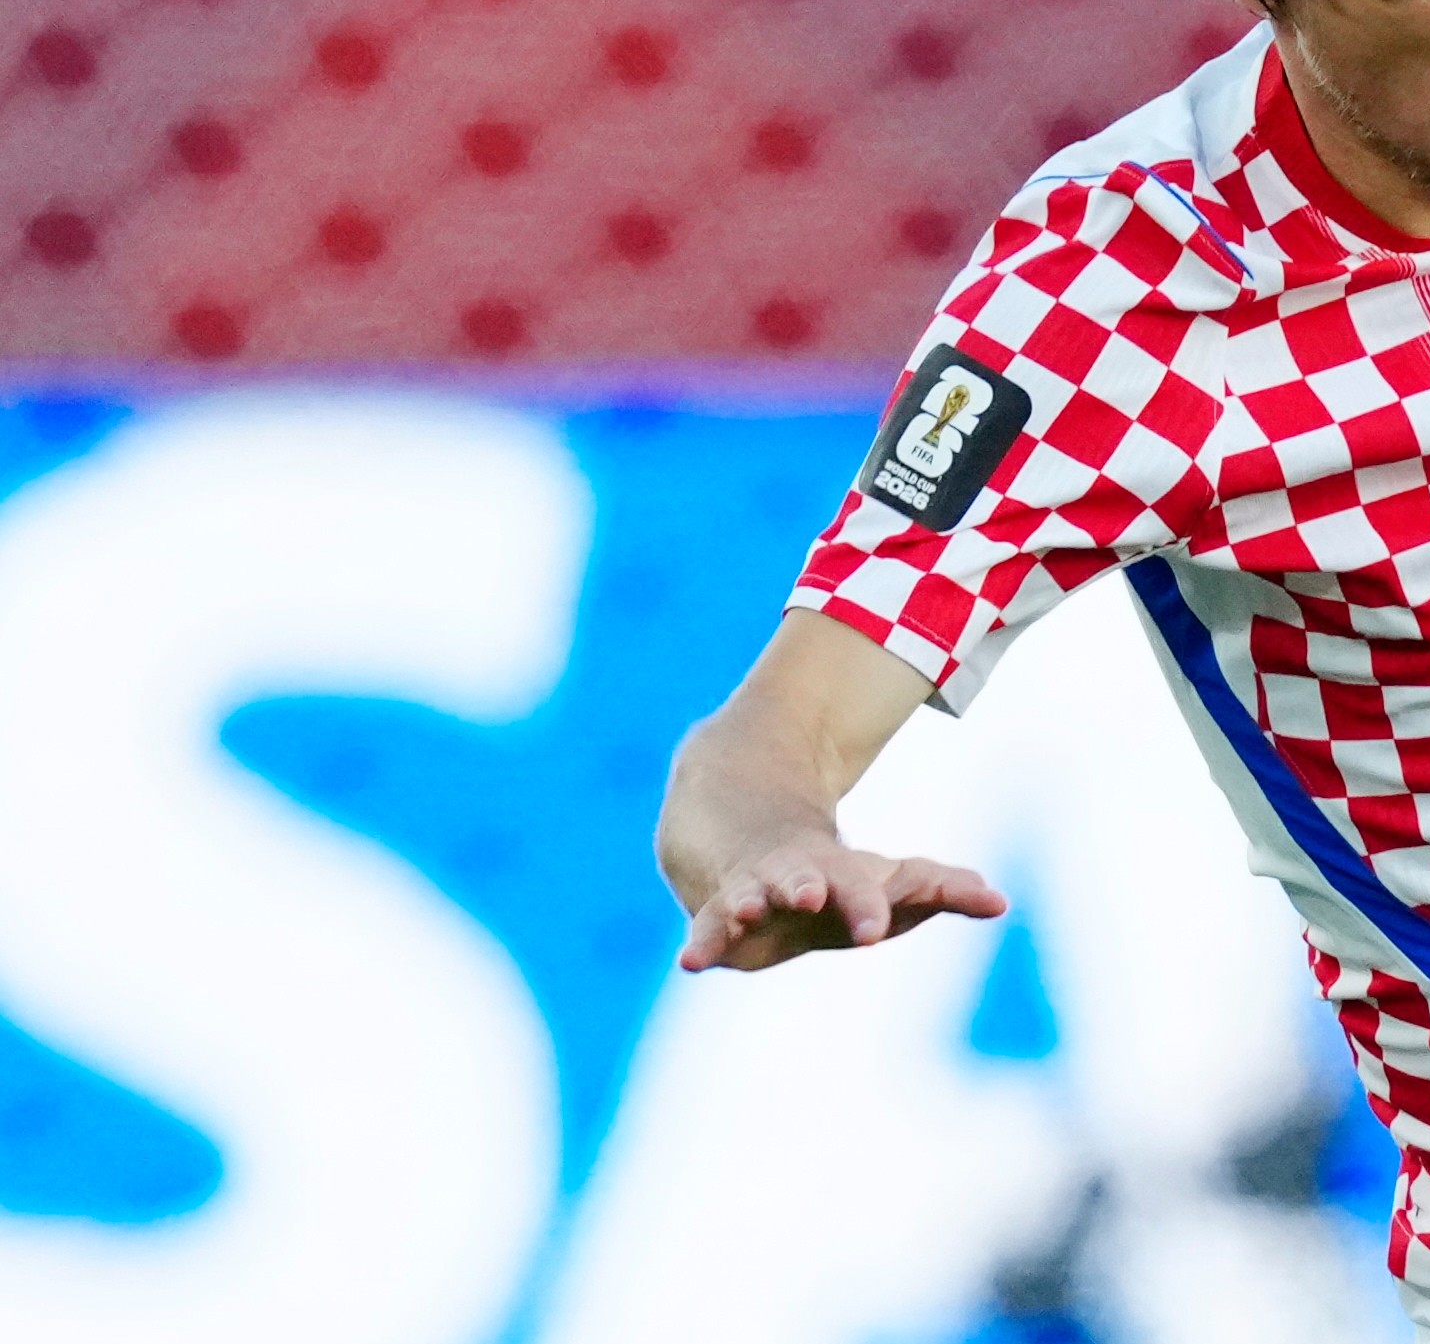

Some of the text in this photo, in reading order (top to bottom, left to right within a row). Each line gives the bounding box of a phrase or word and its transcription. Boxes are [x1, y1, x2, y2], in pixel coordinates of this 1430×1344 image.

[910, 444, 936, 466] FIFA
[873, 469, 931, 512] 2026
[883, 458, 938, 496] WORLD CUP
